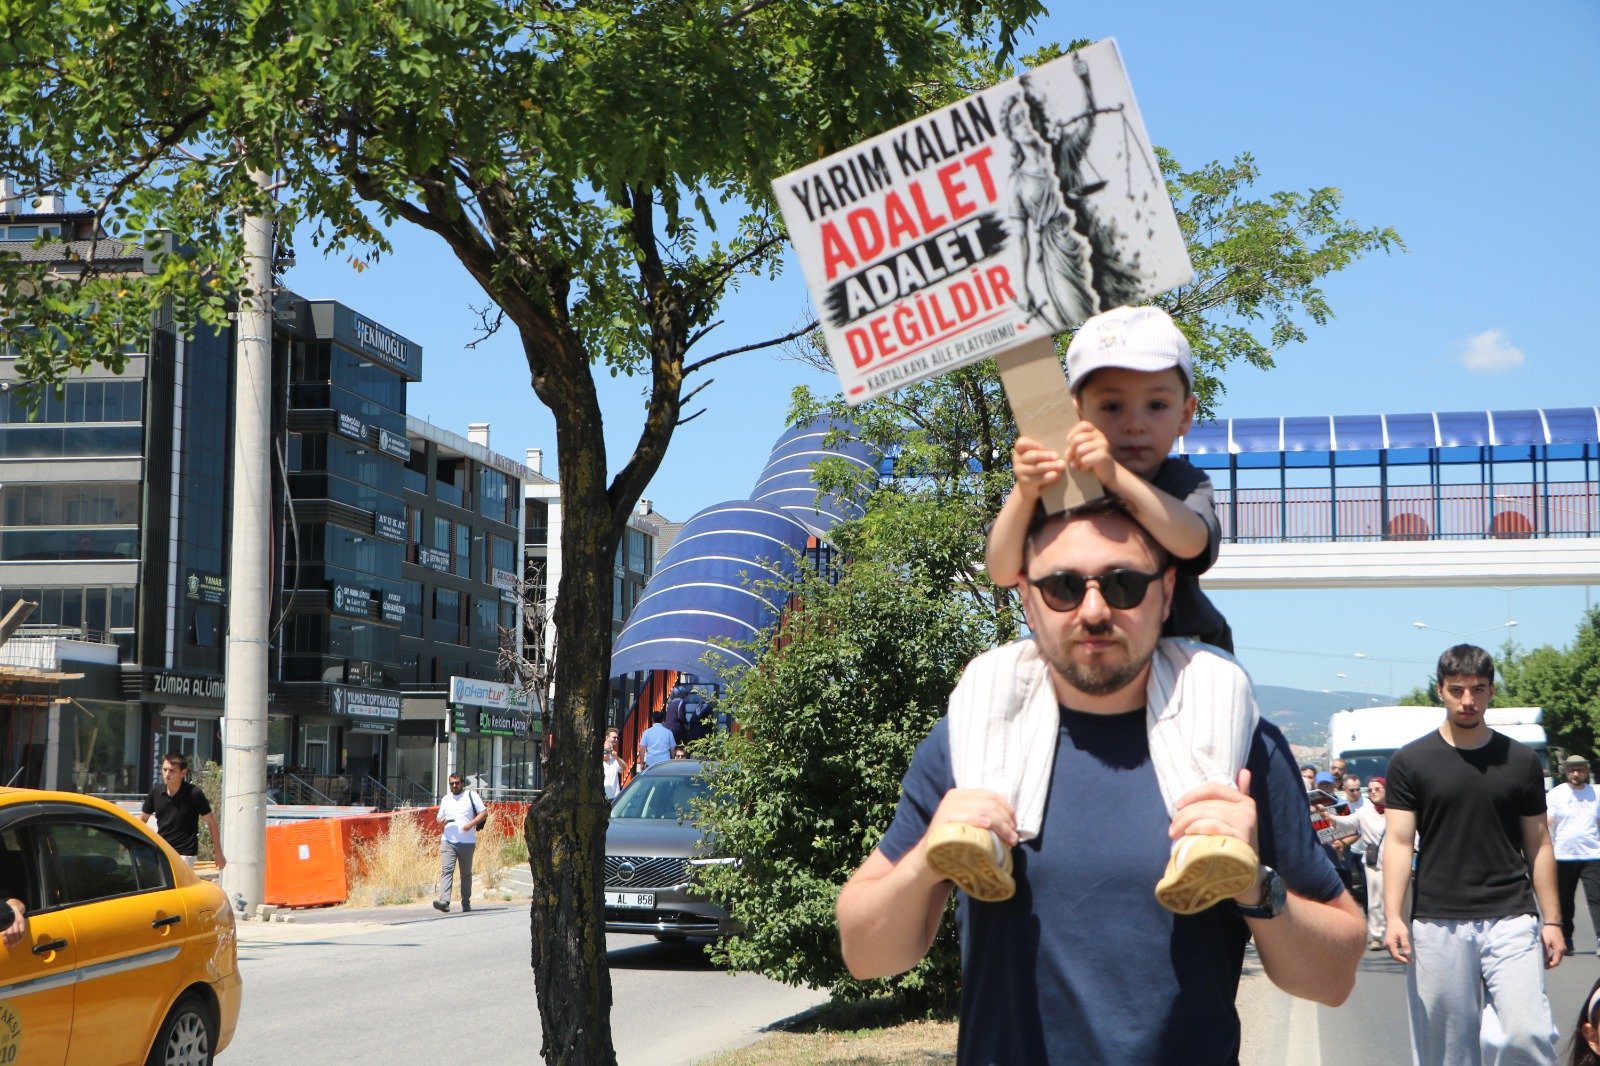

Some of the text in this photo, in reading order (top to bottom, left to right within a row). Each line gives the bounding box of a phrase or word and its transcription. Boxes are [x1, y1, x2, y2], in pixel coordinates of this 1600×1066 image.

[790, 96, 998, 223] YARIM KALAN
[819, 146, 1000, 282] ADALET
[845, 219, 988, 319] ADALET
[845, 264, 1017, 369] DEĞİLDİR
[867, 322, 1017, 393] KARTALKAYA AİLE PLATFORMU
[378, 514, 406, 530] AVUKAT
[154, 671, 225, 699] ZÜMRA ALÜMİN
[366, 694, 388, 707] TOPTAN
[388, 697, 400, 708] GIDA
[617, 893, 653, 905] AL 858
[0, 1044, 16, 1064] 10
